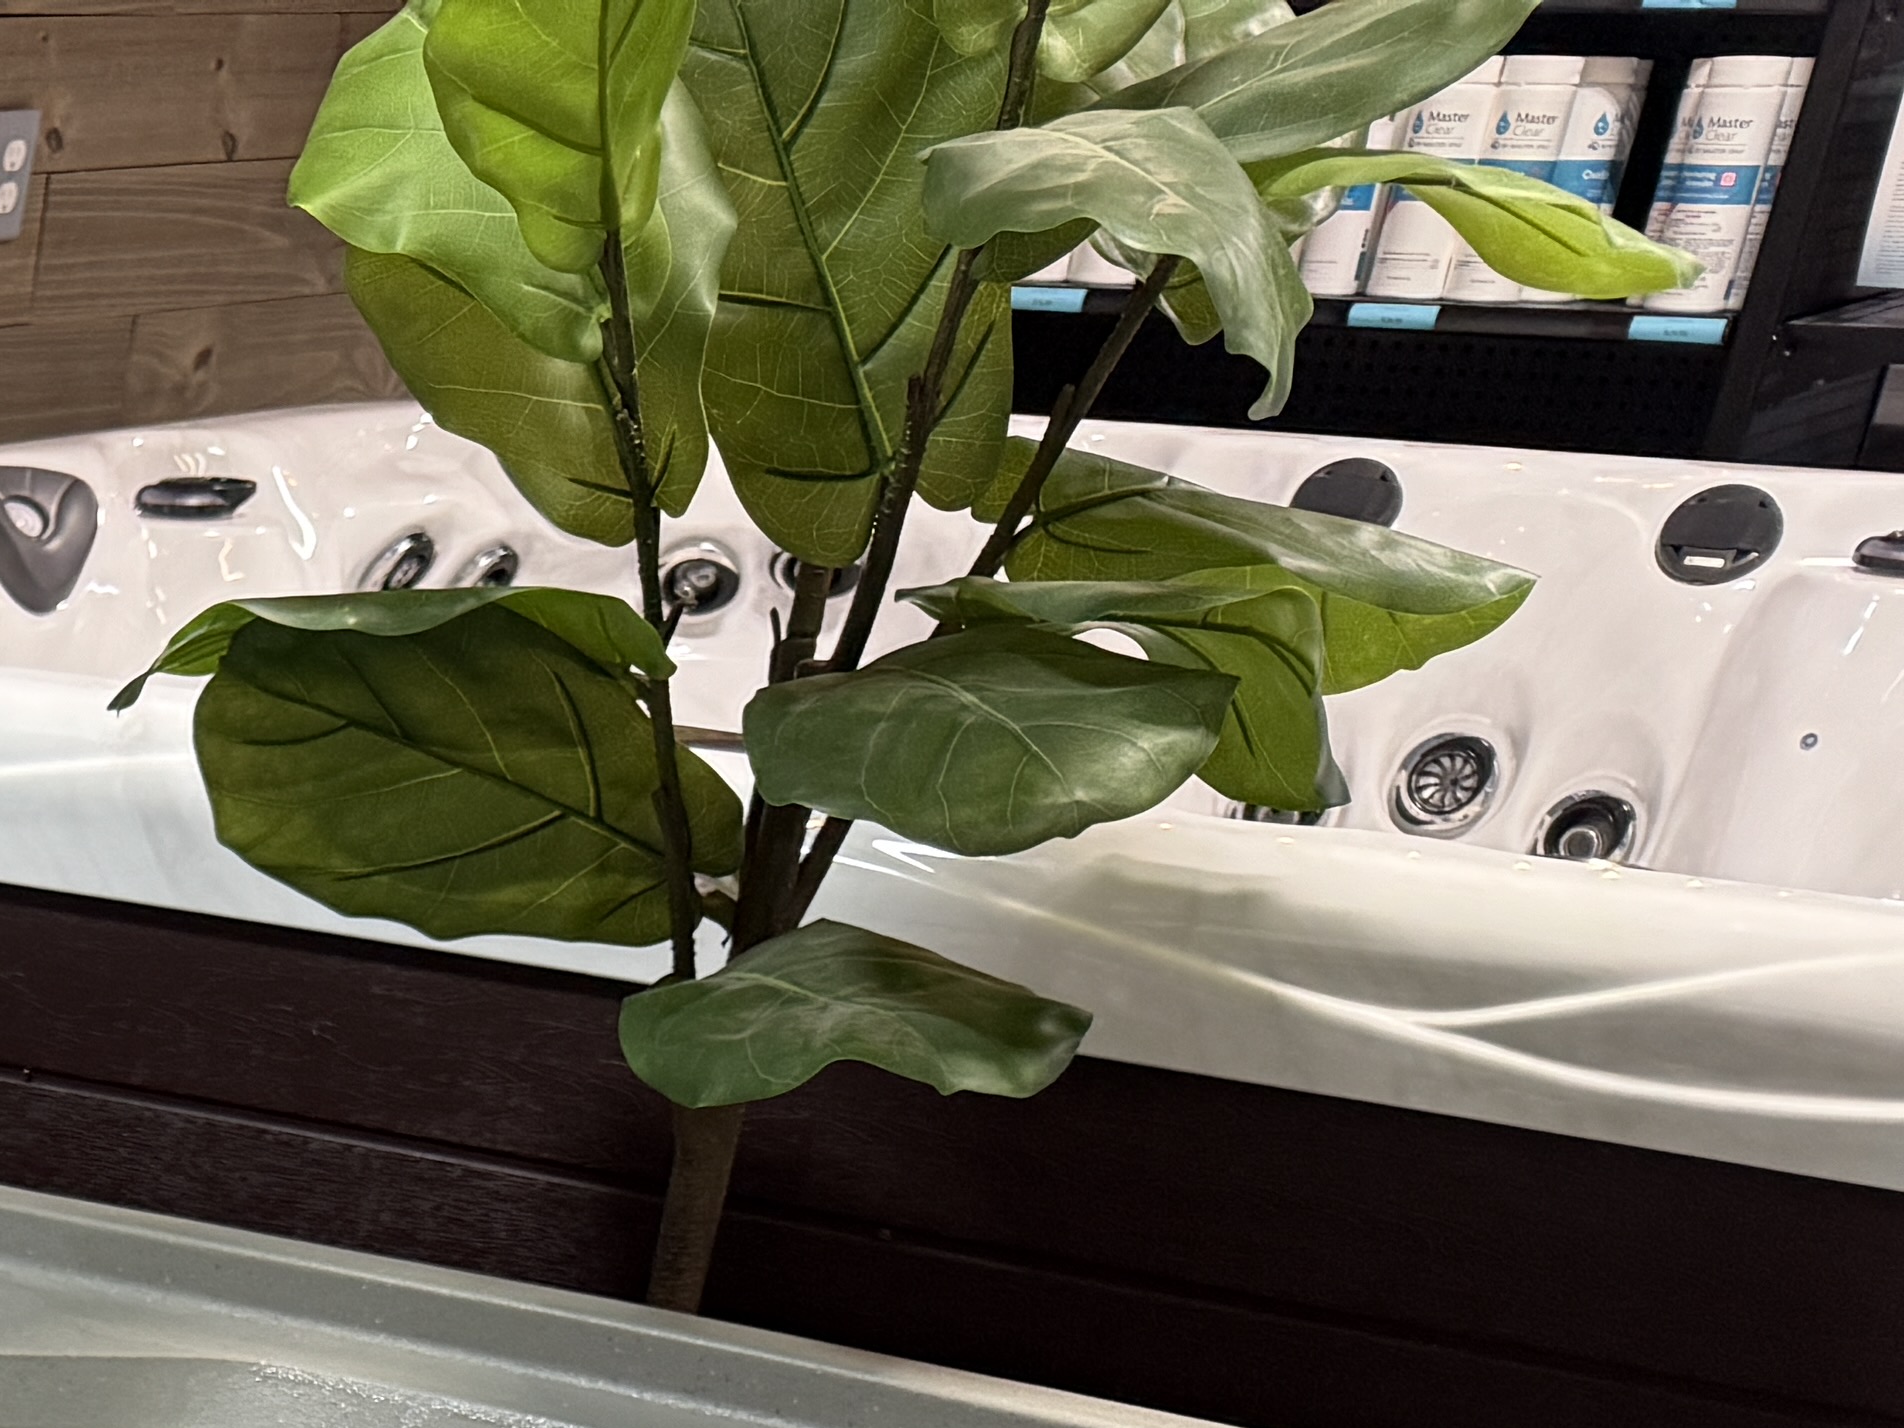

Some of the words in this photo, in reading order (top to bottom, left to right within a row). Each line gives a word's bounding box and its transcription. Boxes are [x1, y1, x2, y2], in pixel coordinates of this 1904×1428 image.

[1428, 110, 1469, 123] Master
[1515, 111, 1558, 126] Master
[1708, 116, 1753, 129] Master
